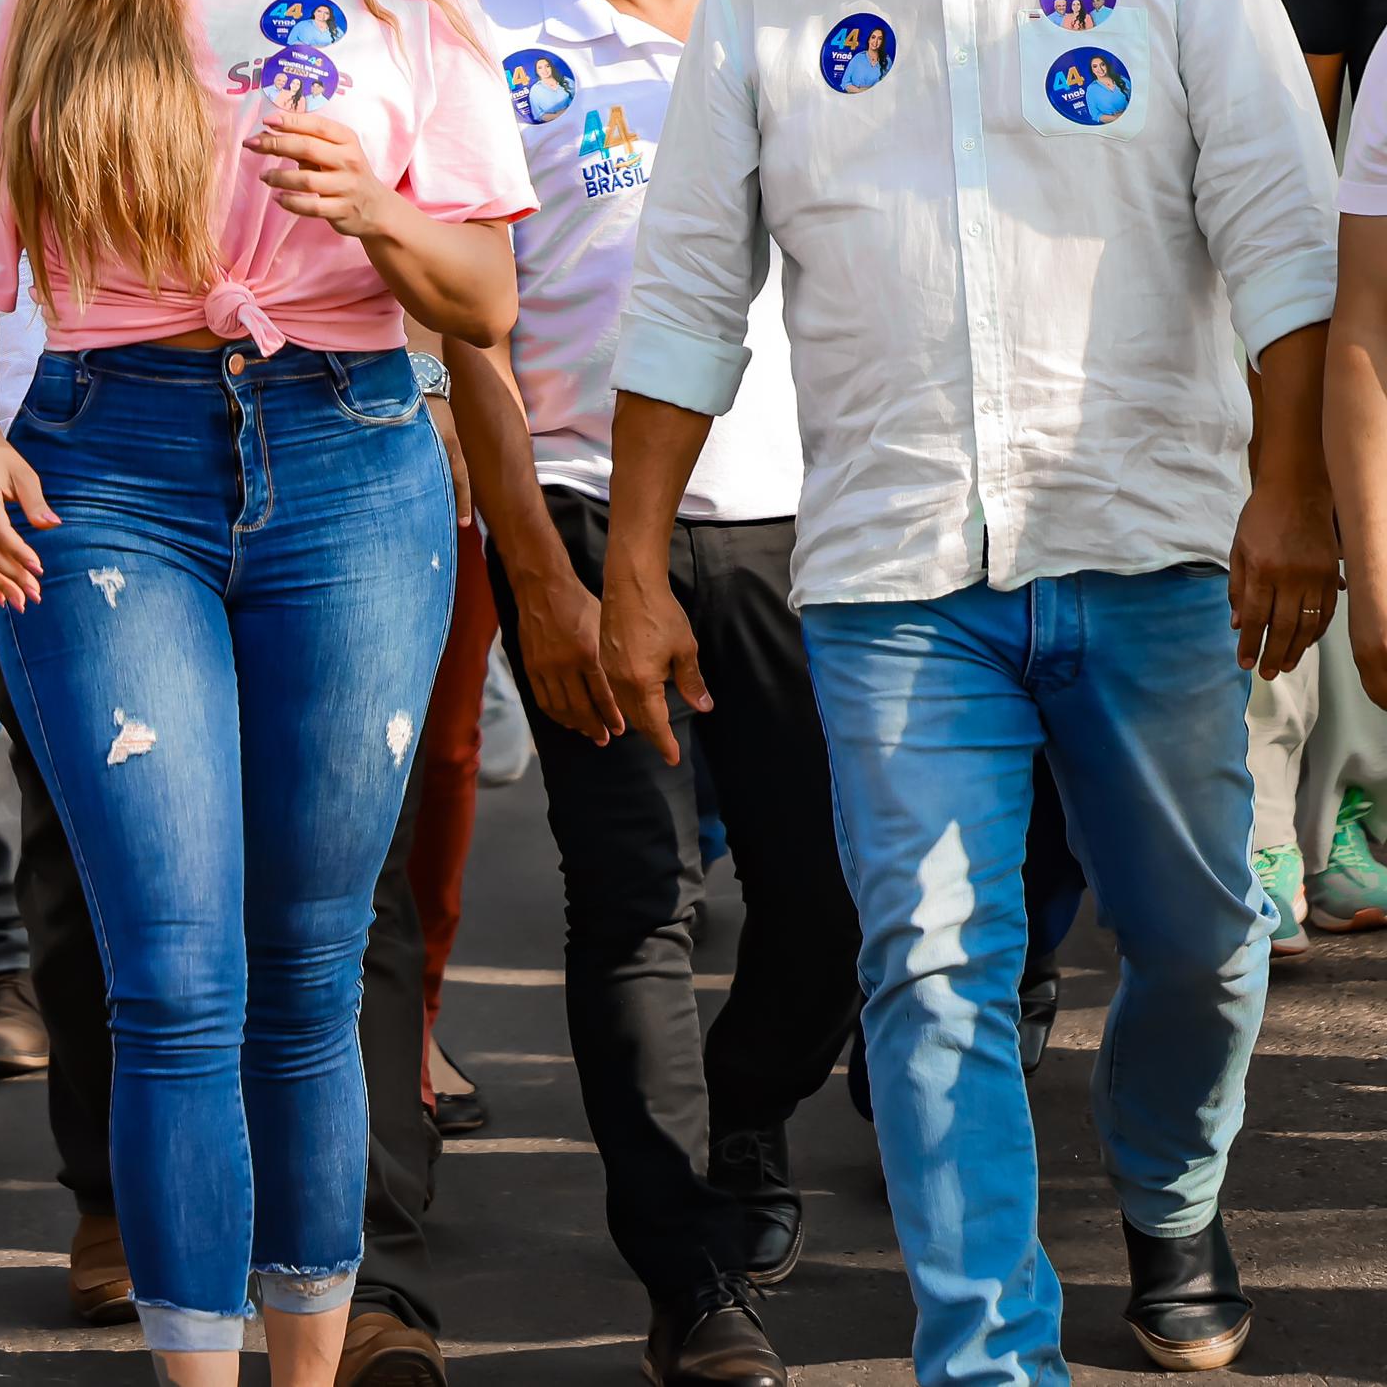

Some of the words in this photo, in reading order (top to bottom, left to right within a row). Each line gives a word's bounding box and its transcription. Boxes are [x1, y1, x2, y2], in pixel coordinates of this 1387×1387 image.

[830, 28, 859, 50] 44
[1053, 66, 1085, 91] 44
[579, 104, 640, 160] 44
[585, 167, 650, 198] BRASIL
